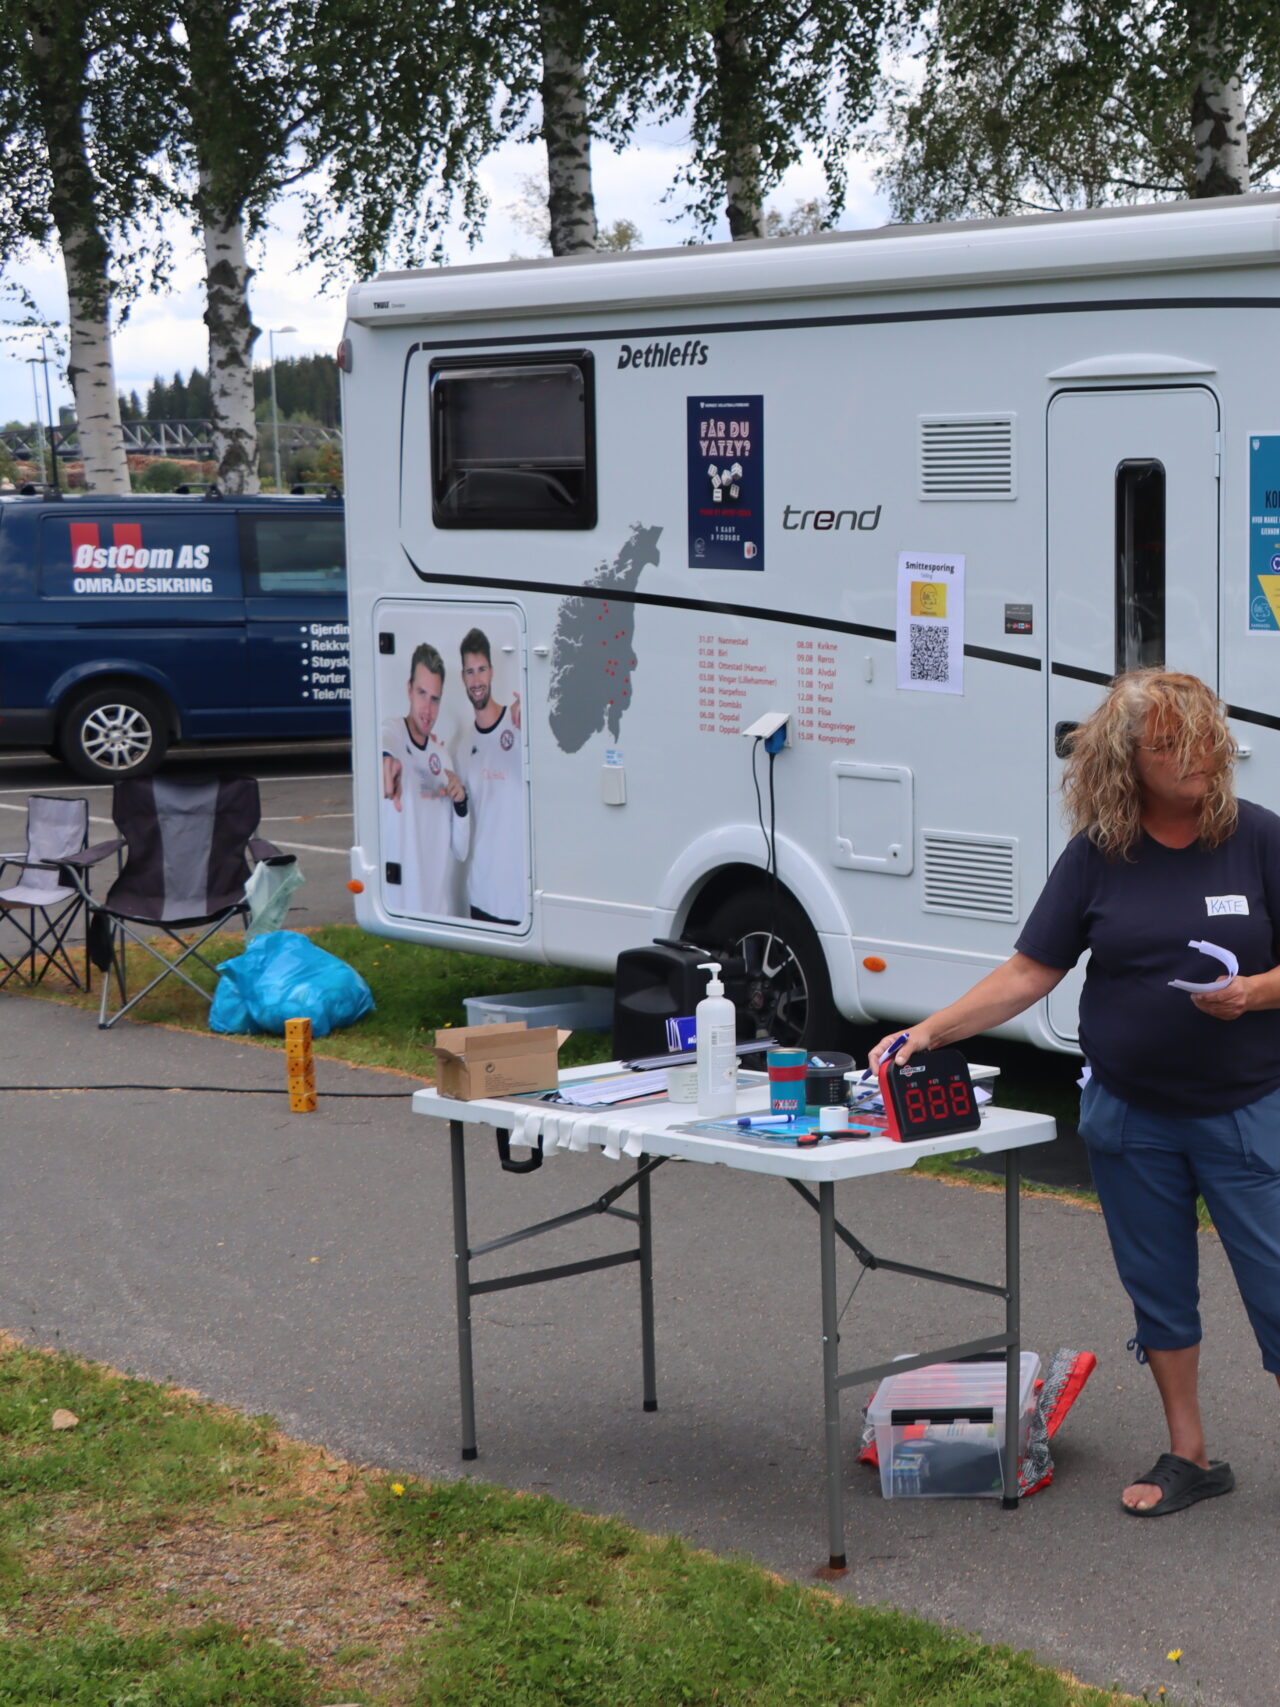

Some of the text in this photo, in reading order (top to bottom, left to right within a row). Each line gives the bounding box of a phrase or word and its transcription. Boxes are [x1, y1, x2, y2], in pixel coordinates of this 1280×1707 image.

[617, 340, 709, 369] Dethleffs
[700, 418, 750, 438] FÅR DU
[699, 440, 751, 457] YATZY?
[782, 505, 882, 531] trend
[73, 544, 211, 570] ØstCom AS
[905, 561, 955, 574] Smittesporing
[73, 573, 213, 593] OMRÅDESIKRING
[312, 672, 346, 684] Porter
[818, 721, 856, 732] Kongsvinger
[818, 734, 856, 745] Kongsvinger
[1210, 899, 1246, 914] KATE
